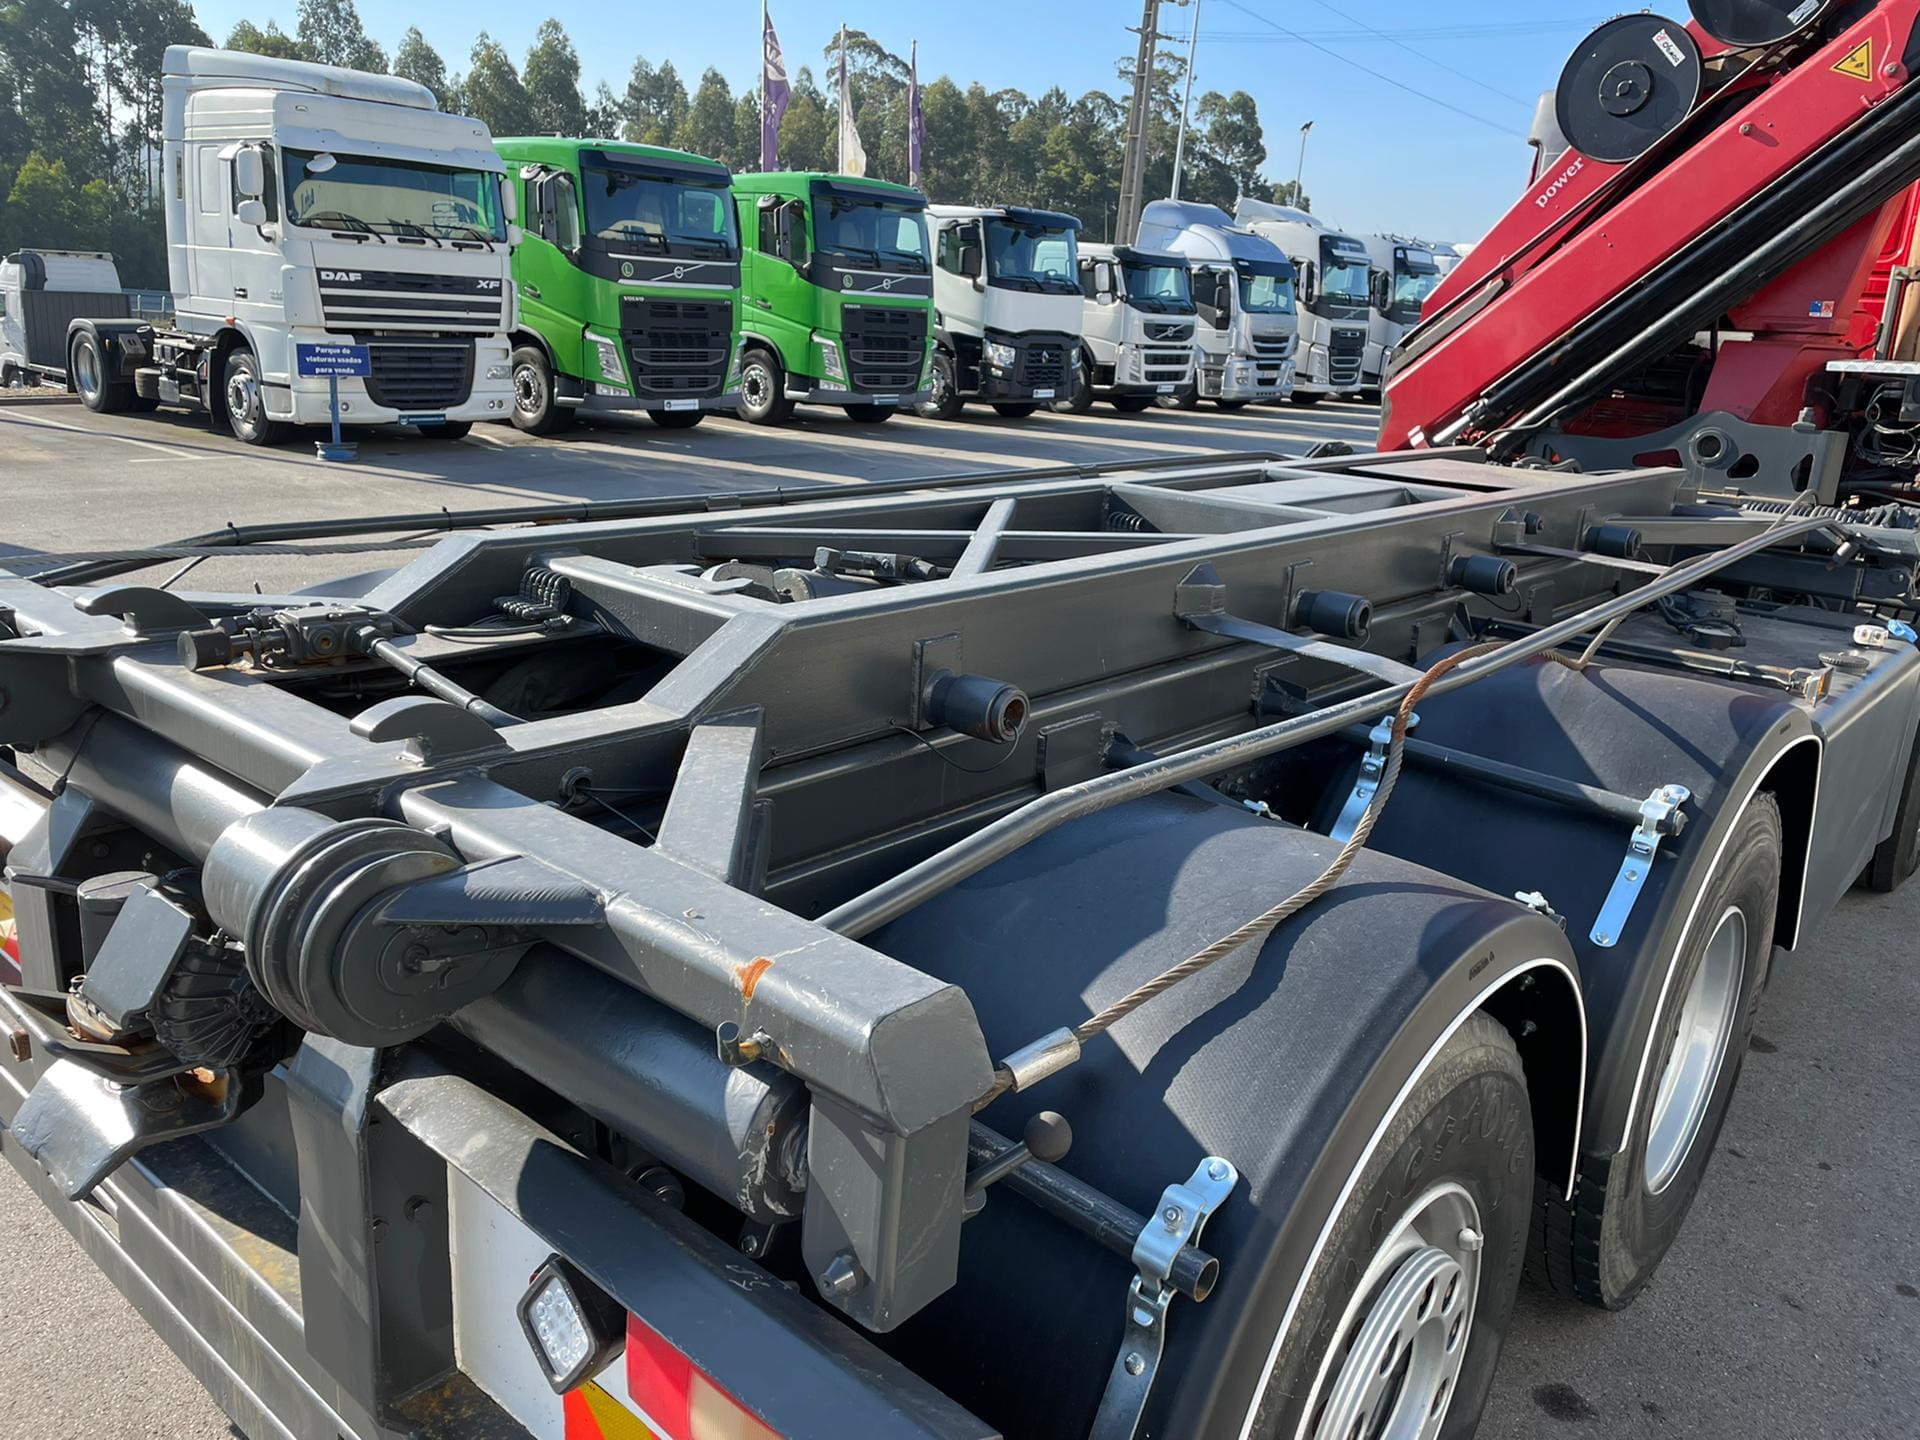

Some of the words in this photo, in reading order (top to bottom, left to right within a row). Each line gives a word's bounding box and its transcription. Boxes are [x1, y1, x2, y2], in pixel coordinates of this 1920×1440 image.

[1536, 157, 1584, 208] power
[320, 270, 362, 281] DAF
[476, 279, 500, 289] XF
[315, 346, 340, 355] Parque
[305, 355, 336, 363] viaturas
[337, 356, 362, 364] usadas
[315, 367, 333, 375] para
